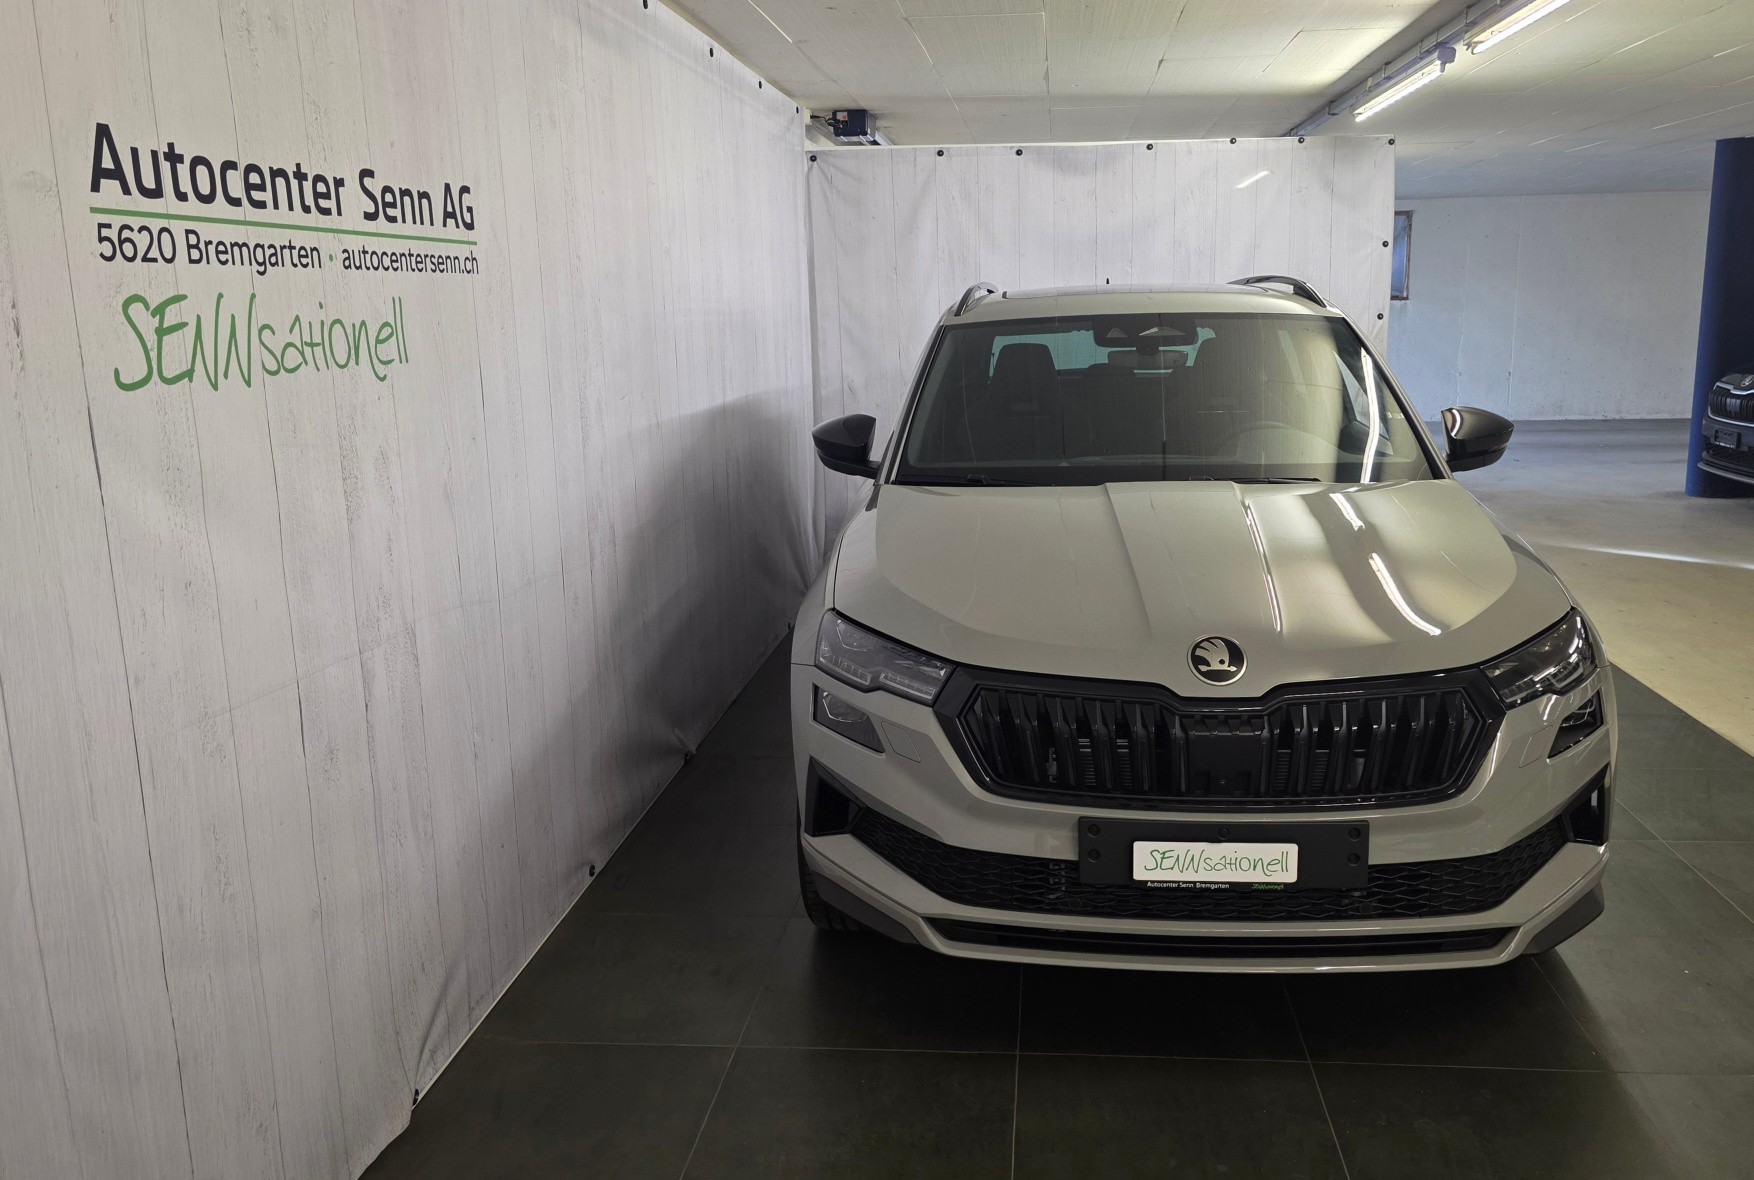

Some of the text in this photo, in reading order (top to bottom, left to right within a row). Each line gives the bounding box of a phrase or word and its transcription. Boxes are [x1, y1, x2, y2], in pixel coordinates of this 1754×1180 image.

[90, 122, 476, 231] Autocenter Senn AG
[97, 222, 480, 276] 5620 Bremgarten autocentersenn.ch
[114, 292, 409, 391] SENNsationell
[1144, 849, 1289, 877] SENNsationell
[1196, 882, 1230, 890] Bremgarten
